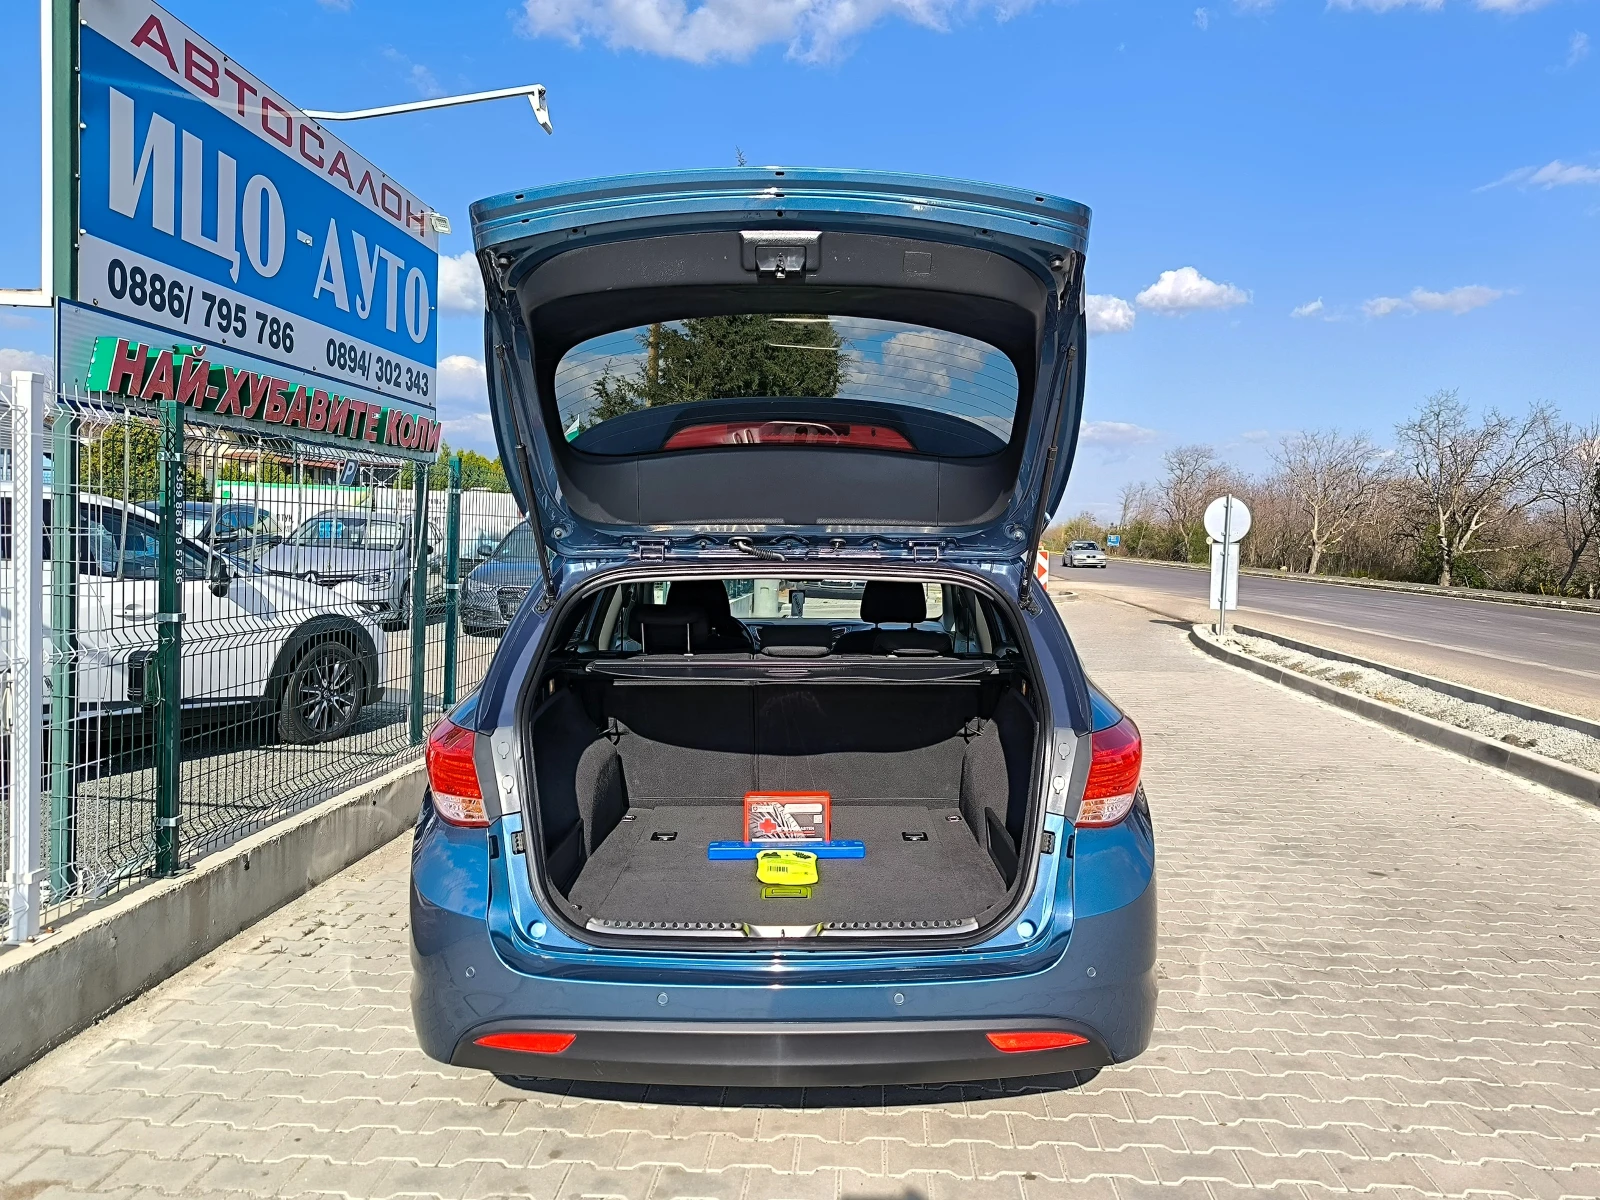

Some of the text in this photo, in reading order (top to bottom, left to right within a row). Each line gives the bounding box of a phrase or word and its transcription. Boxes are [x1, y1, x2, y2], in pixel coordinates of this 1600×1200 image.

[131, 14, 425, 238] АВТОСАЛОН
[107, 259, 295, 354] 0886/ 795 786
[107, 338, 442, 453] НАЙ-ХУБАВИТЕ КОЛИ
[326, 338, 430, 397] 0894/ 302 343
[175, 466, 183, 584] +359 886 79 57 86
